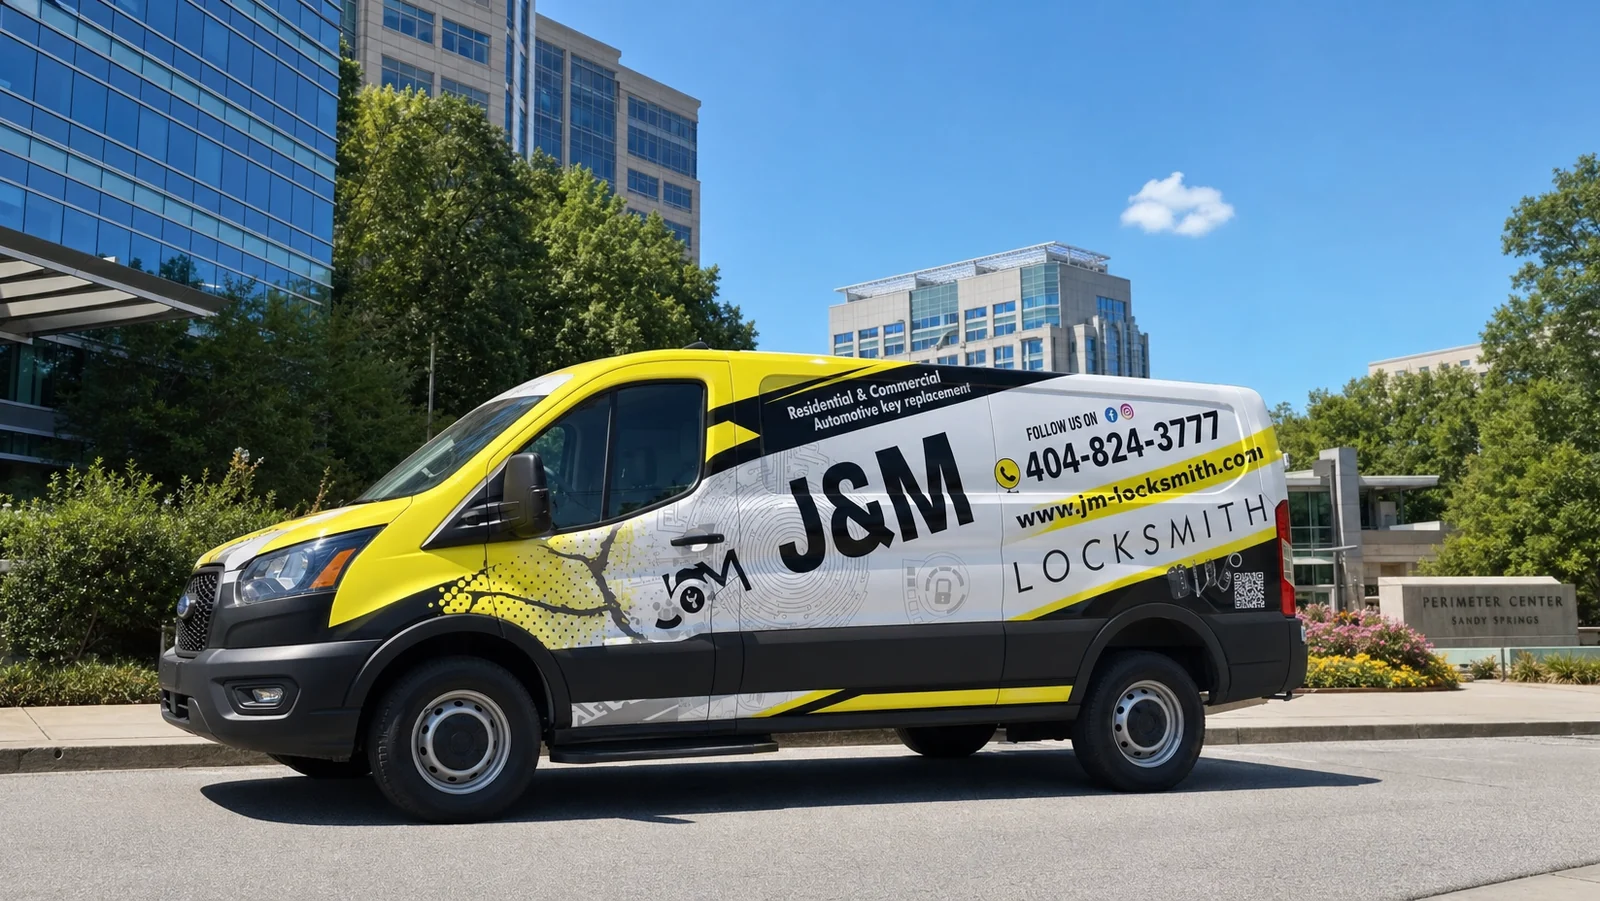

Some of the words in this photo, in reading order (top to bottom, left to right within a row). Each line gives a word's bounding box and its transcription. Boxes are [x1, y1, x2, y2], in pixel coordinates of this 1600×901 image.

[787, 390, 854, 420] Residential
[857, 388, 867, 402] &
[869, 370, 941, 398] Commercial
[814, 404, 879, 431] Automotive
[881, 400, 901, 413] key
[904, 382, 972, 408] replacement
[1025, 410, 1219, 482] 404-824-3777
[1026, 417, 1067, 441] FOLLOW
[1069, 414, 1083, 431] US
[1083, 411, 1098, 427] ON
[778, 431, 974, 573] J&M
[1015, 444, 1265, 529] www.jm-locksmith.com
[1013, 494, 1268, 594] LOCKSMITH
[1422, 596, 1500, 609] PERIMETER
[1509, 595, 1564, 608] CENTER
[1451, 616, 1487, 626] SANDY
[1493, 615, 1539, 625] SPRINGS
